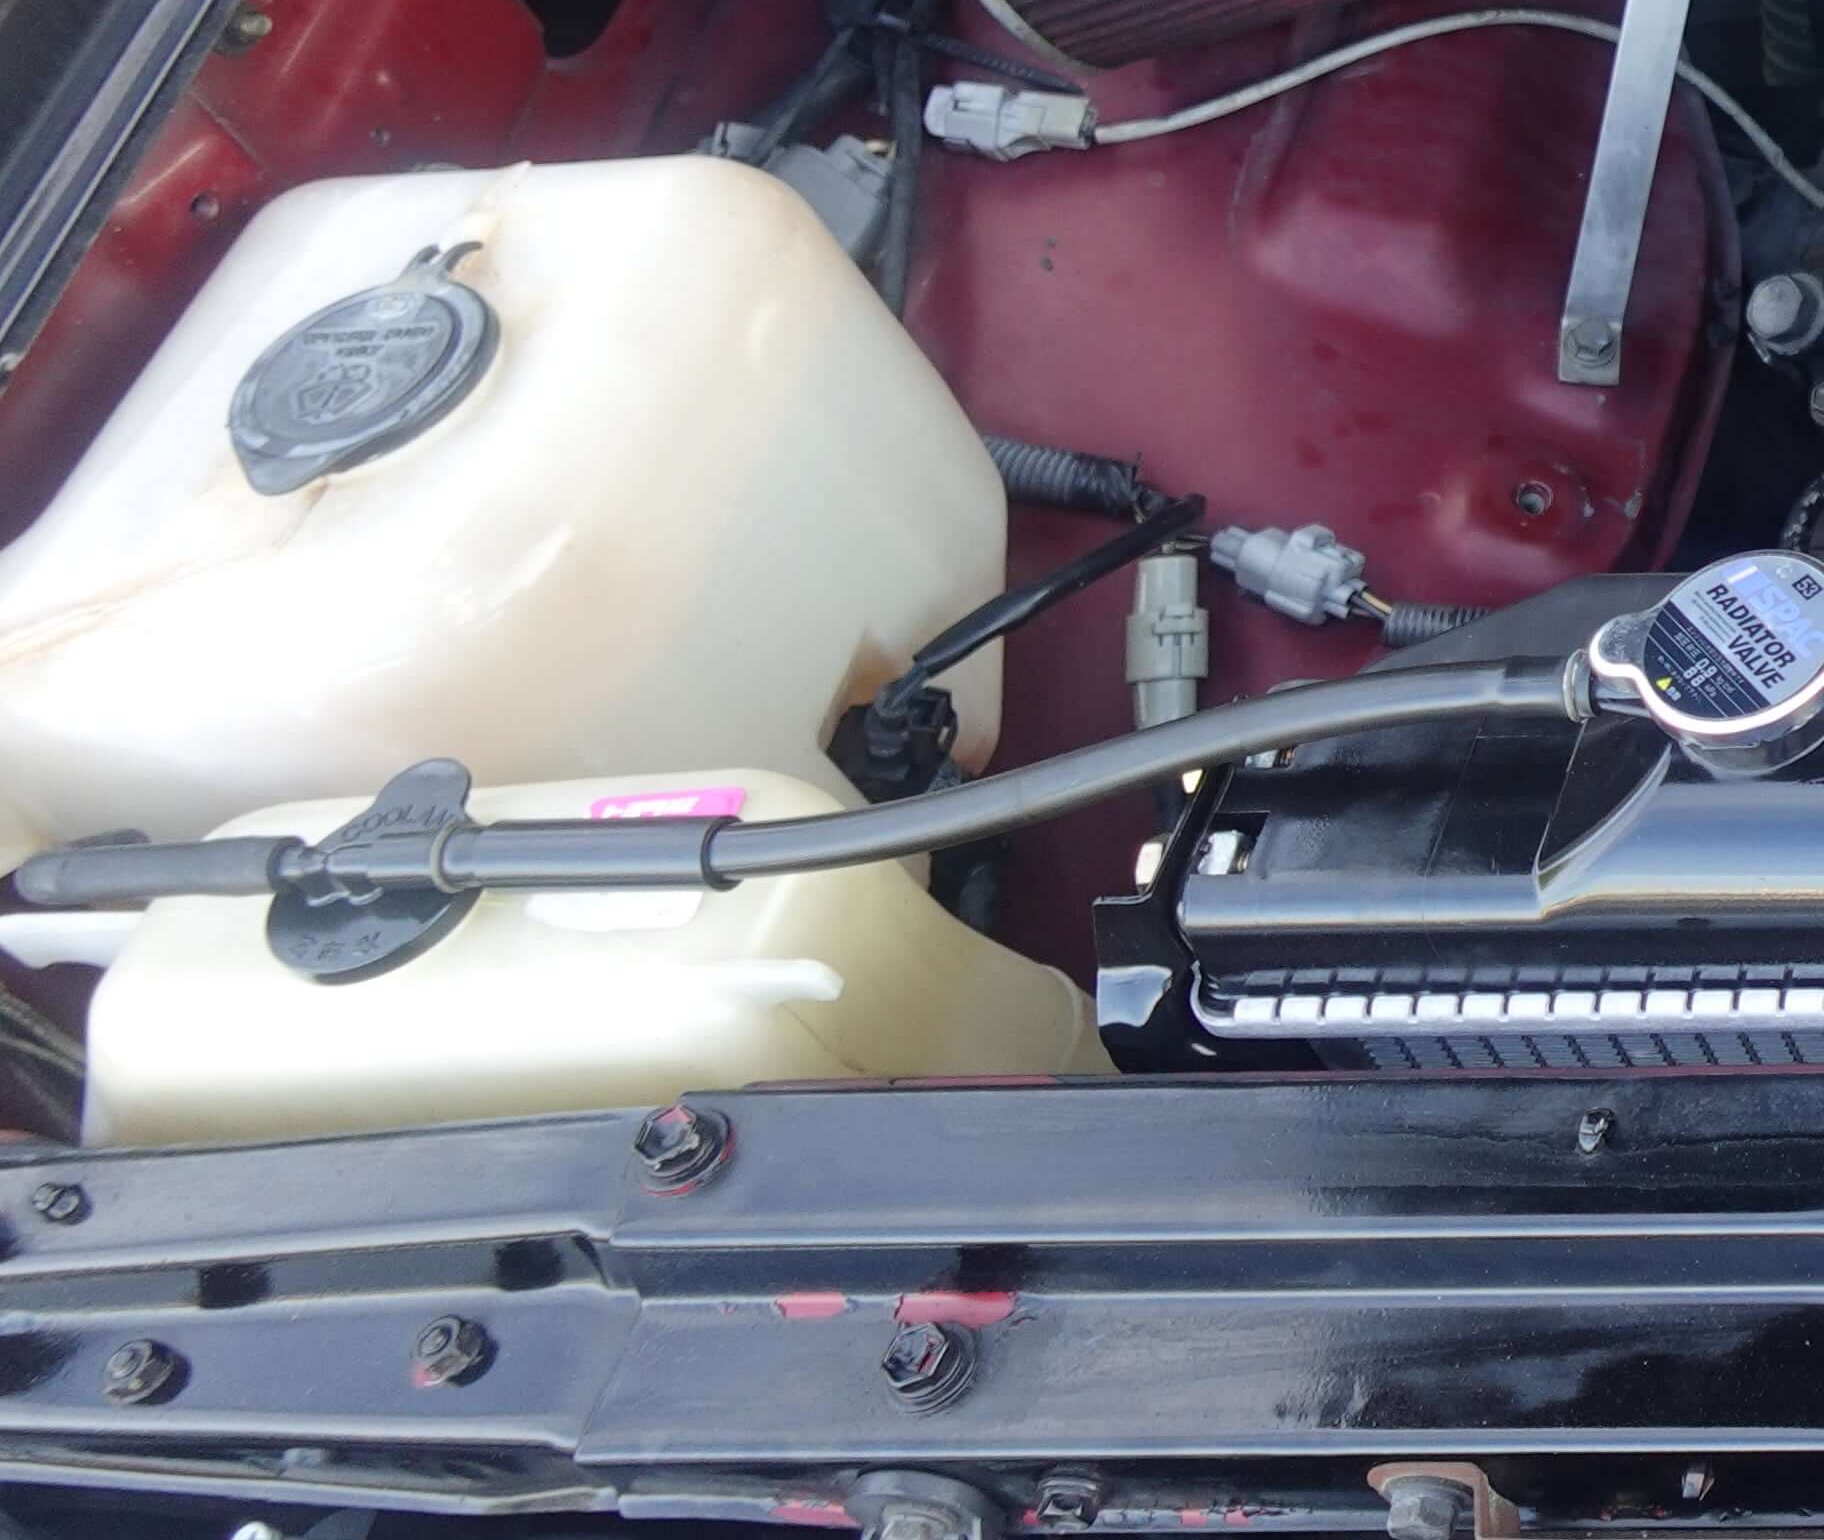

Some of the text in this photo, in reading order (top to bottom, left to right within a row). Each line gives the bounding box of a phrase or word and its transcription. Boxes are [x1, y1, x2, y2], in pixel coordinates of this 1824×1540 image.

[1795, 576, 1820, 599] 53
[1706, 583, 1797, 668] RADIATOR
[1683, 665, 1705, 687] 88
[1727, 634, 1785, 690] VALVE
